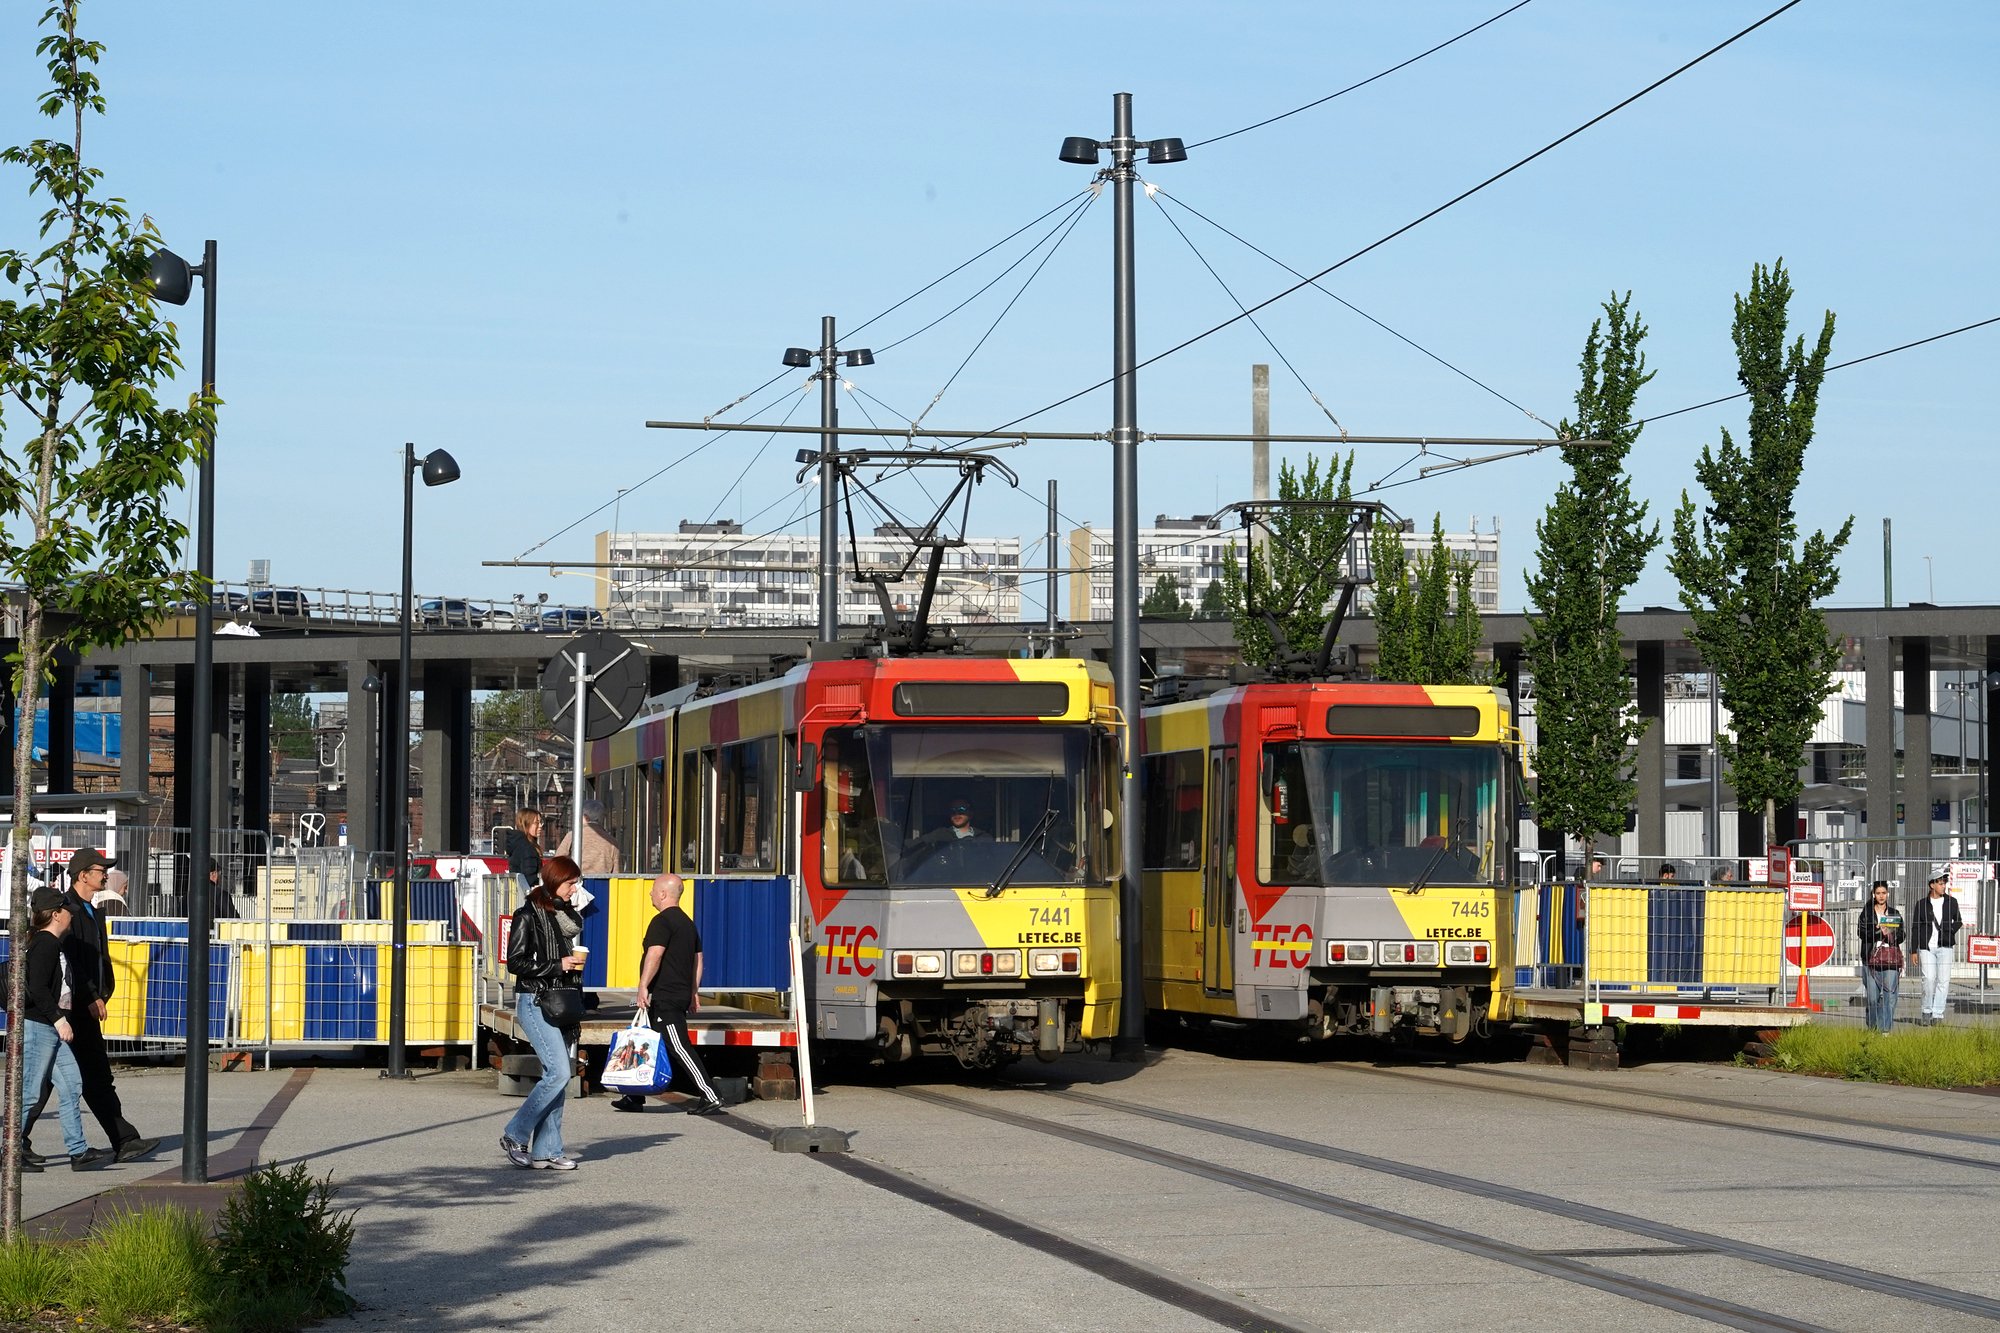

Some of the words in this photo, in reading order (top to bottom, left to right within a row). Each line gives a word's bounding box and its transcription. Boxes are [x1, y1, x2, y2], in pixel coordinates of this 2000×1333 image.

[1061, 890, 1067, 898] A
[1029, 907, 1070, 926] 7441
[1451, 901, 1489, 918] 7445
[1018, 932, 1081, 944] LETEC.BE
[1426, 928, 1482, 938] LETEC.BE
[824, 925, 878, 977] TEC
[1251, 923, 1313, 969] TEC
